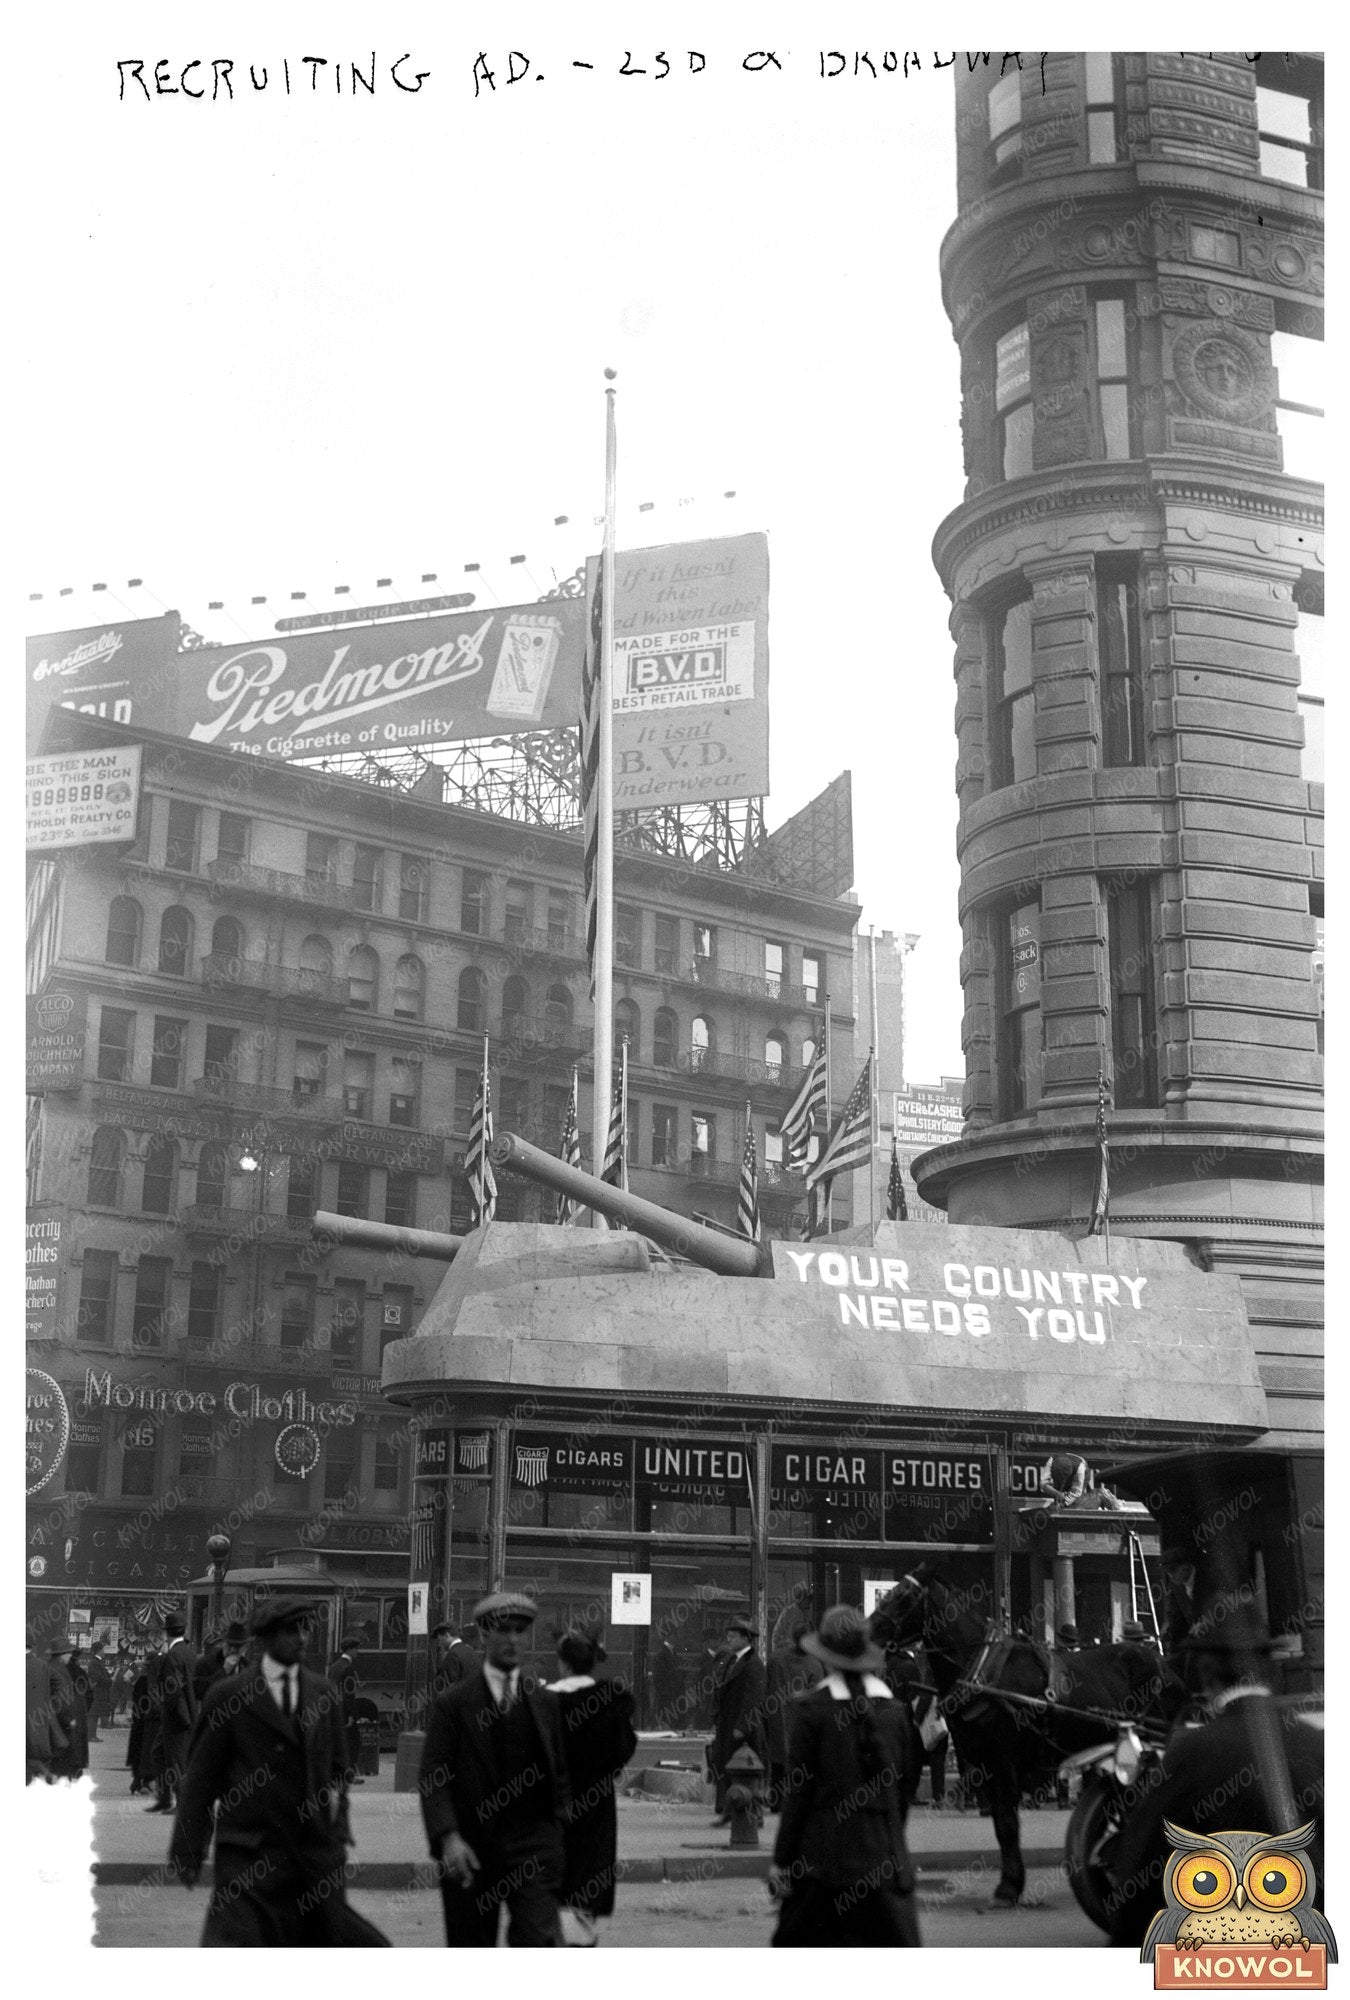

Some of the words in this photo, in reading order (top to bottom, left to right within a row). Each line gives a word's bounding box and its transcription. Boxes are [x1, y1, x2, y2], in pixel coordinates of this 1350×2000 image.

[117, 52, 431, 101] RECRUITING
[473, 52, 545, 97] AD.
[623, 568, 647, 593] If
[650, 563, 665, 582] it
[613, 613, 637, 630] ed
[709, 595, 761, 618] Label
[614, 636, 663, 652] MADE
[670, 631, 700, 645] FOR
[706, 625, 740, 640] THE
[636, 652, 721, 686] B.V.D.
[613, 696, 647, 709] BEST
[651, 690, 698, 704] RETAIL
[701, 684, 742, 699] TRADE
[266, 730, 352, 756] Cigarette
[358, 725, 380, 742] of
[384, 718, 454, 741] Quality
[50, 760, 79, 773] THE
[85, 756, 117, 769] MAN
[59, 773, 90, 784] THIS
[97, 768, 132, 781] SIGN
[41, 999, 70, 1010] ALCO
[31, 1035, 74, 1048] ARNOLD
[103, 1111, 151, 1128] EAGLE
[156, 1114, 250, 1143] MUSLI
[786, 1249, 911, 1292] YOUR
[943, 1263, 1148, 1309] COUNTRY
[838, 1293, 992, 1338] NEEDS
[1015, 1305, 1107, 1345] YOU
[331, 1374, 361, 1391] VICTOR
[84, 1367, 217, 1415] Monroe
[223, 1382, 356, 1426] Clothes
[70, 1423, 101, 1433] Monroe
[70, 1432, 100, 1443] Clothes
[128, 1427, 154, 1447] $15
[461, 1438, 487, 1447] CIGARS
[518, 1449, 547, 1458] CIGARS
[556, 1450, 623, 1467] CIGARS
[644, 1447, 744, 1479] UNITED
[785, 1455, 866, 1485] CIGAR
[892, 1459, 982, 1489] STORES
[64, 1560, 191, 1579] CIGARS
